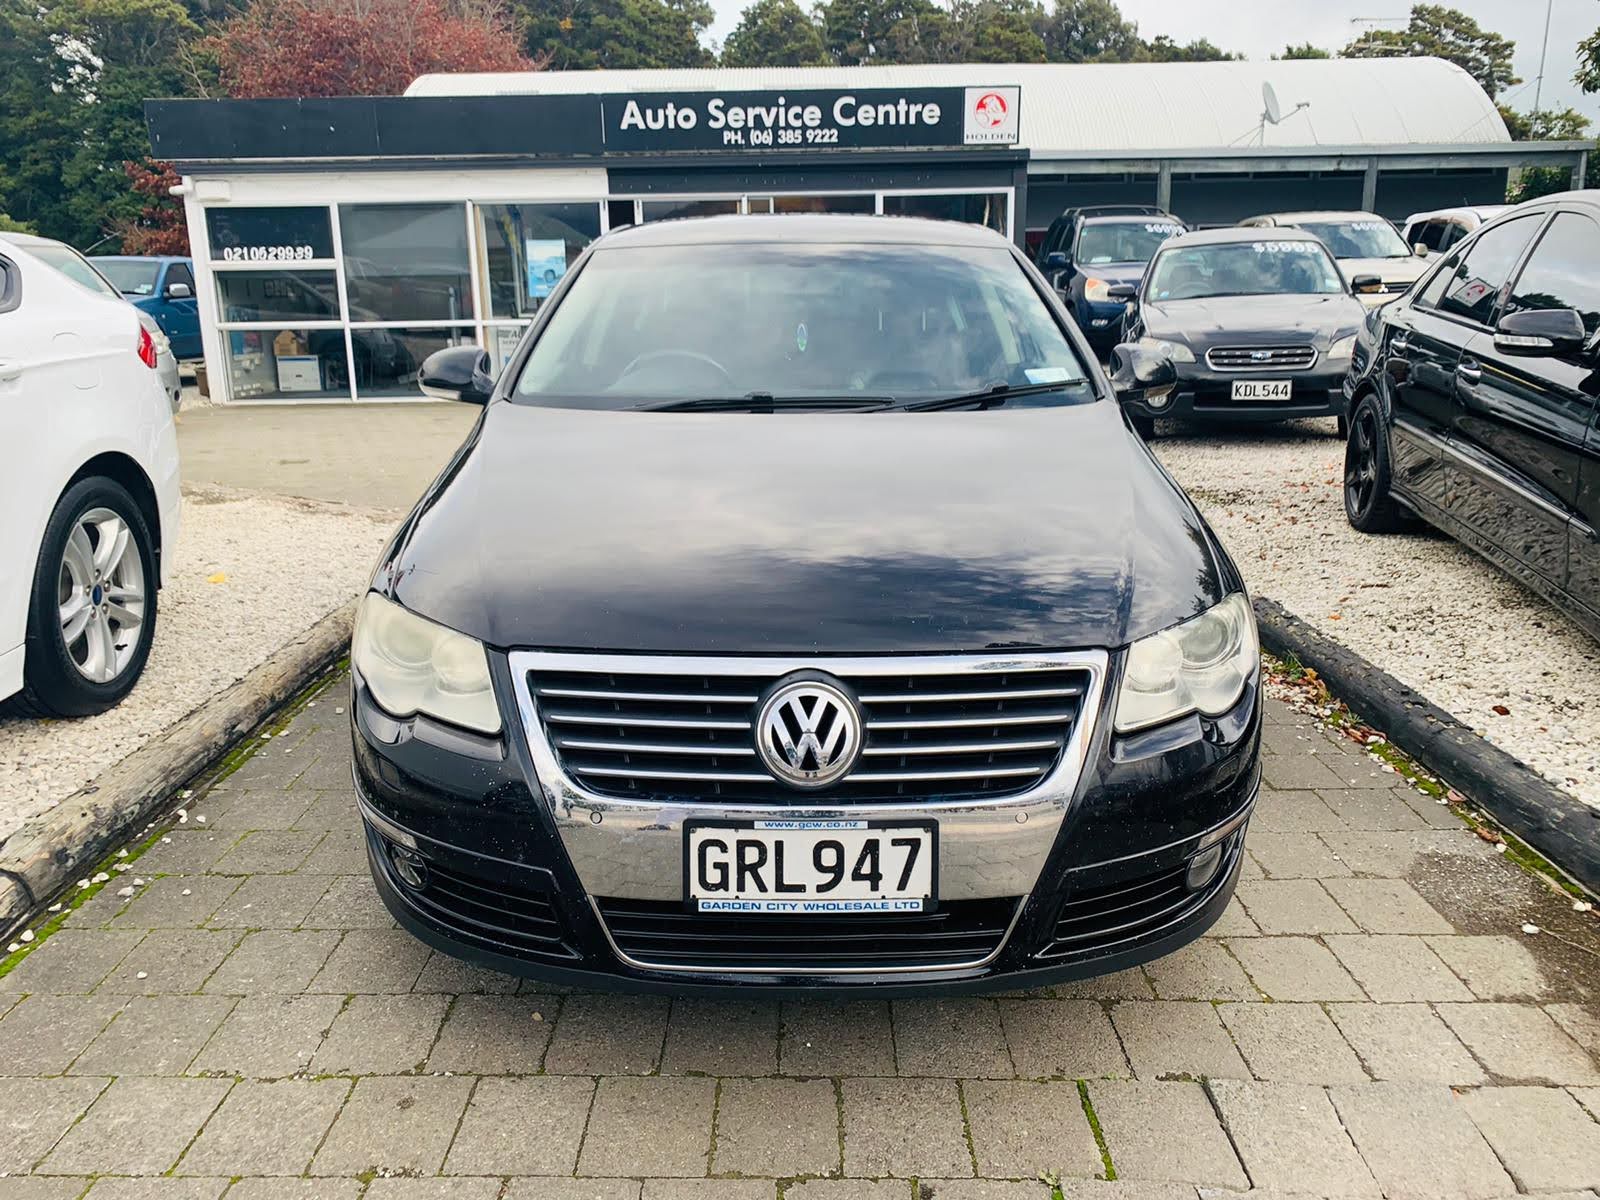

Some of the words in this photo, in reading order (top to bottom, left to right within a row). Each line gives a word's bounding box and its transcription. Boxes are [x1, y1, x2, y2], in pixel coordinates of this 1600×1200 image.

[619, 100, 697, 130] Auto
[707, 96, 822, 129] Service
[832, 95, 941, 127] Centre
[723, 130, 746, 145] PH.
[749, 129, 773, 146] (06)
[777, 129, 803, 144] 385
[805, 128, 839, 143] 9222
[965, 132, 1016, 141] HOLDEN
[1234, 384, 1289, 397] KDL544
[763, 821, 859, 829] www.gcw.co.nz
[701, 902, 762, 910] GARDEN
[766, 903, 799, 911] CITY
[803, 902, 889, 911] WHOLESALE
[894, 901, 920, 909] LTD
